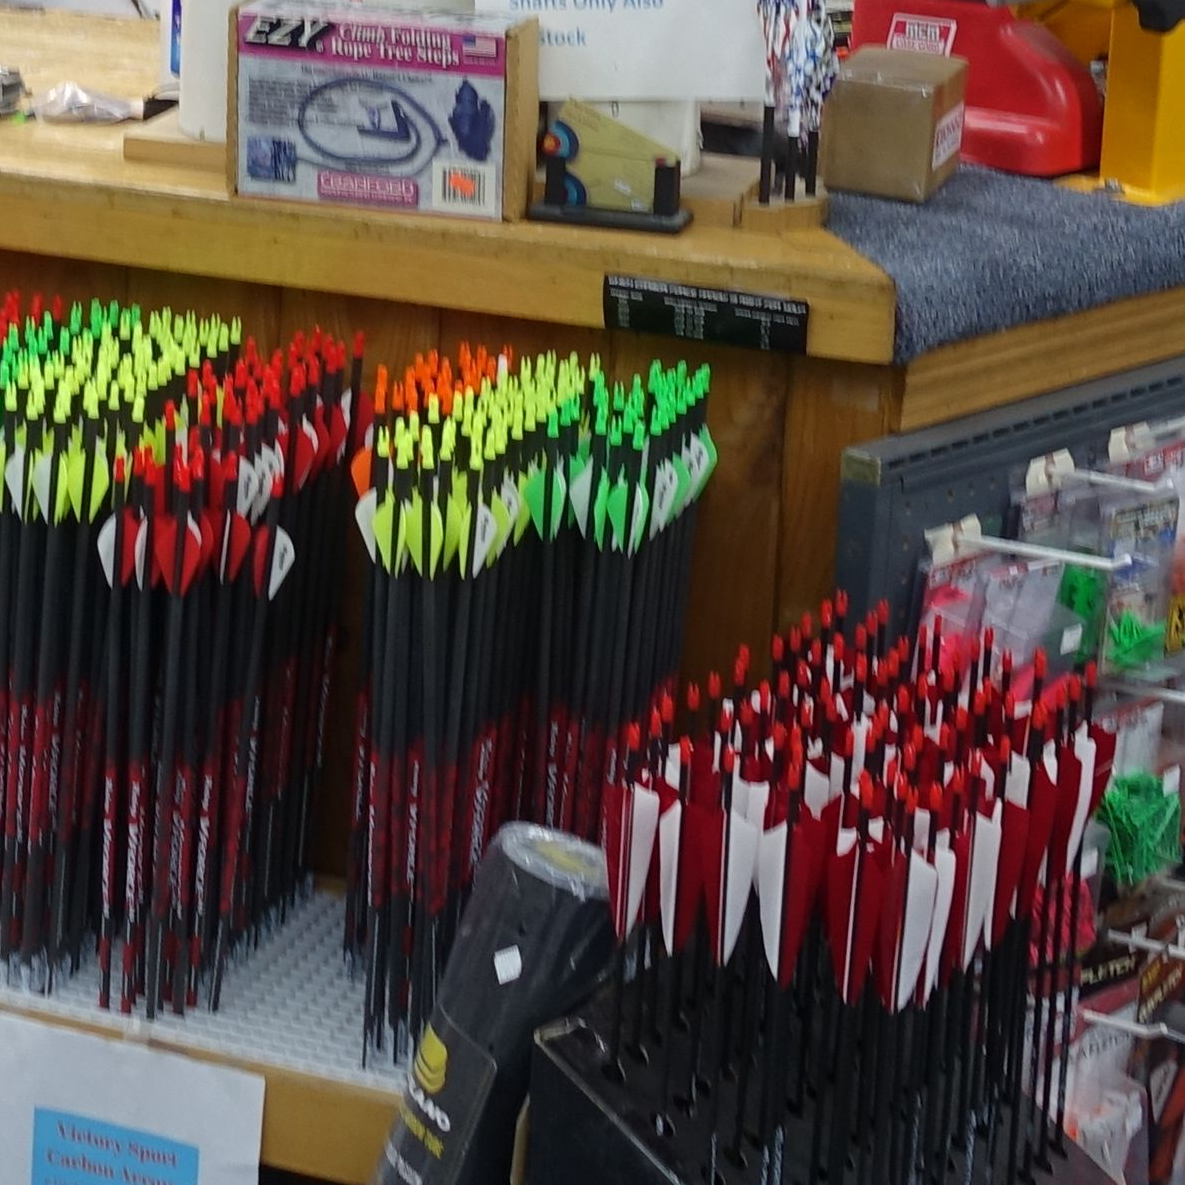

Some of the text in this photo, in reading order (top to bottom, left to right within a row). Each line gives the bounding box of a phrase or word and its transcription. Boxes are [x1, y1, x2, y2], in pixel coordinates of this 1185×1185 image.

[245, 14, 332, 49] EZY
[338, 23, 452, 50] Climb Folding
[331, 37, 459, 69] Rope Tree Steps
[46, 1148, 114, 1179] Carbon
